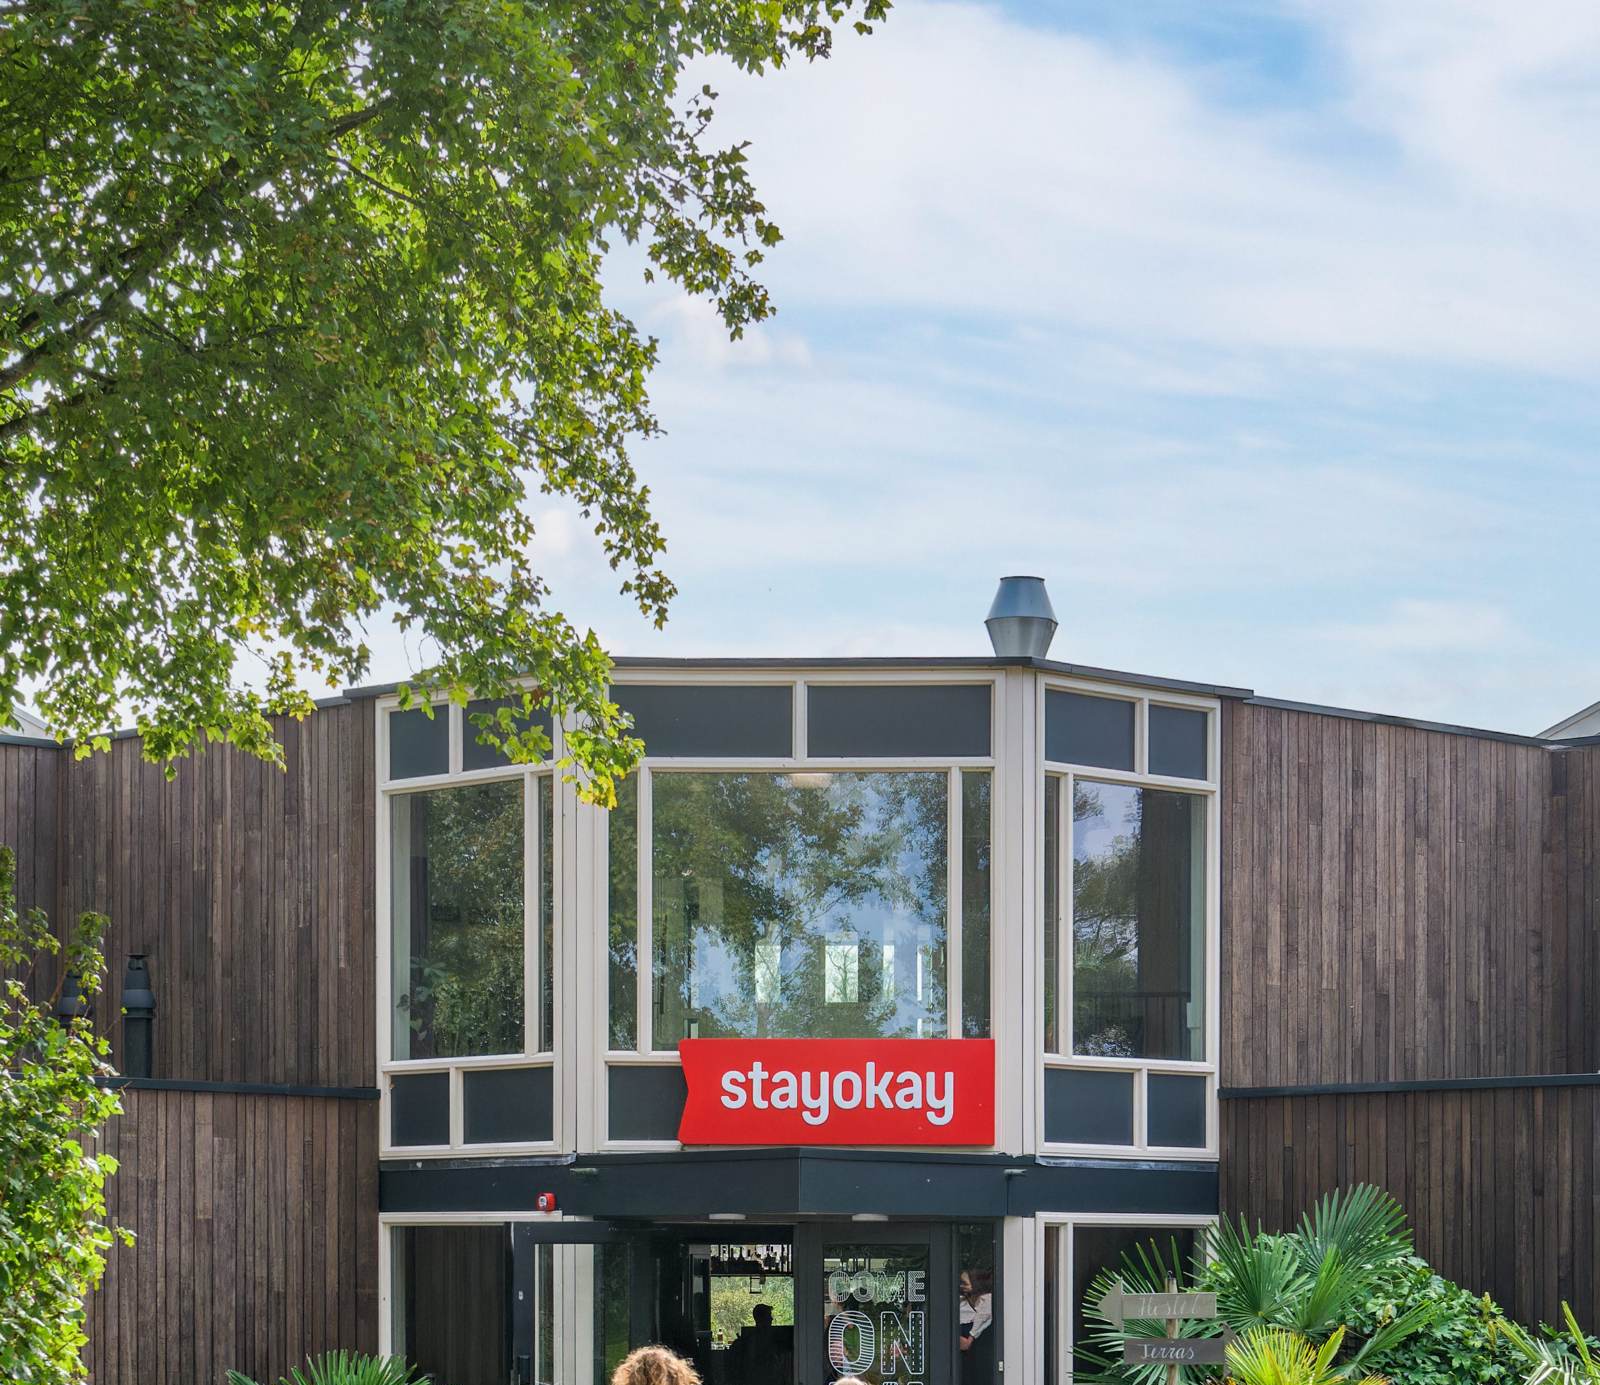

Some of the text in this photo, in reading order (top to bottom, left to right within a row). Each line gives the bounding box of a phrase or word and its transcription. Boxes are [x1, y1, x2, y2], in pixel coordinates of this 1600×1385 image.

[720, 1061, 954, 1126] stayokay
[828, 1271, 925, 1302] COME
[828, 1310, 925, 1376] ON
[1137, 1343, 1195, 1360] Terras
